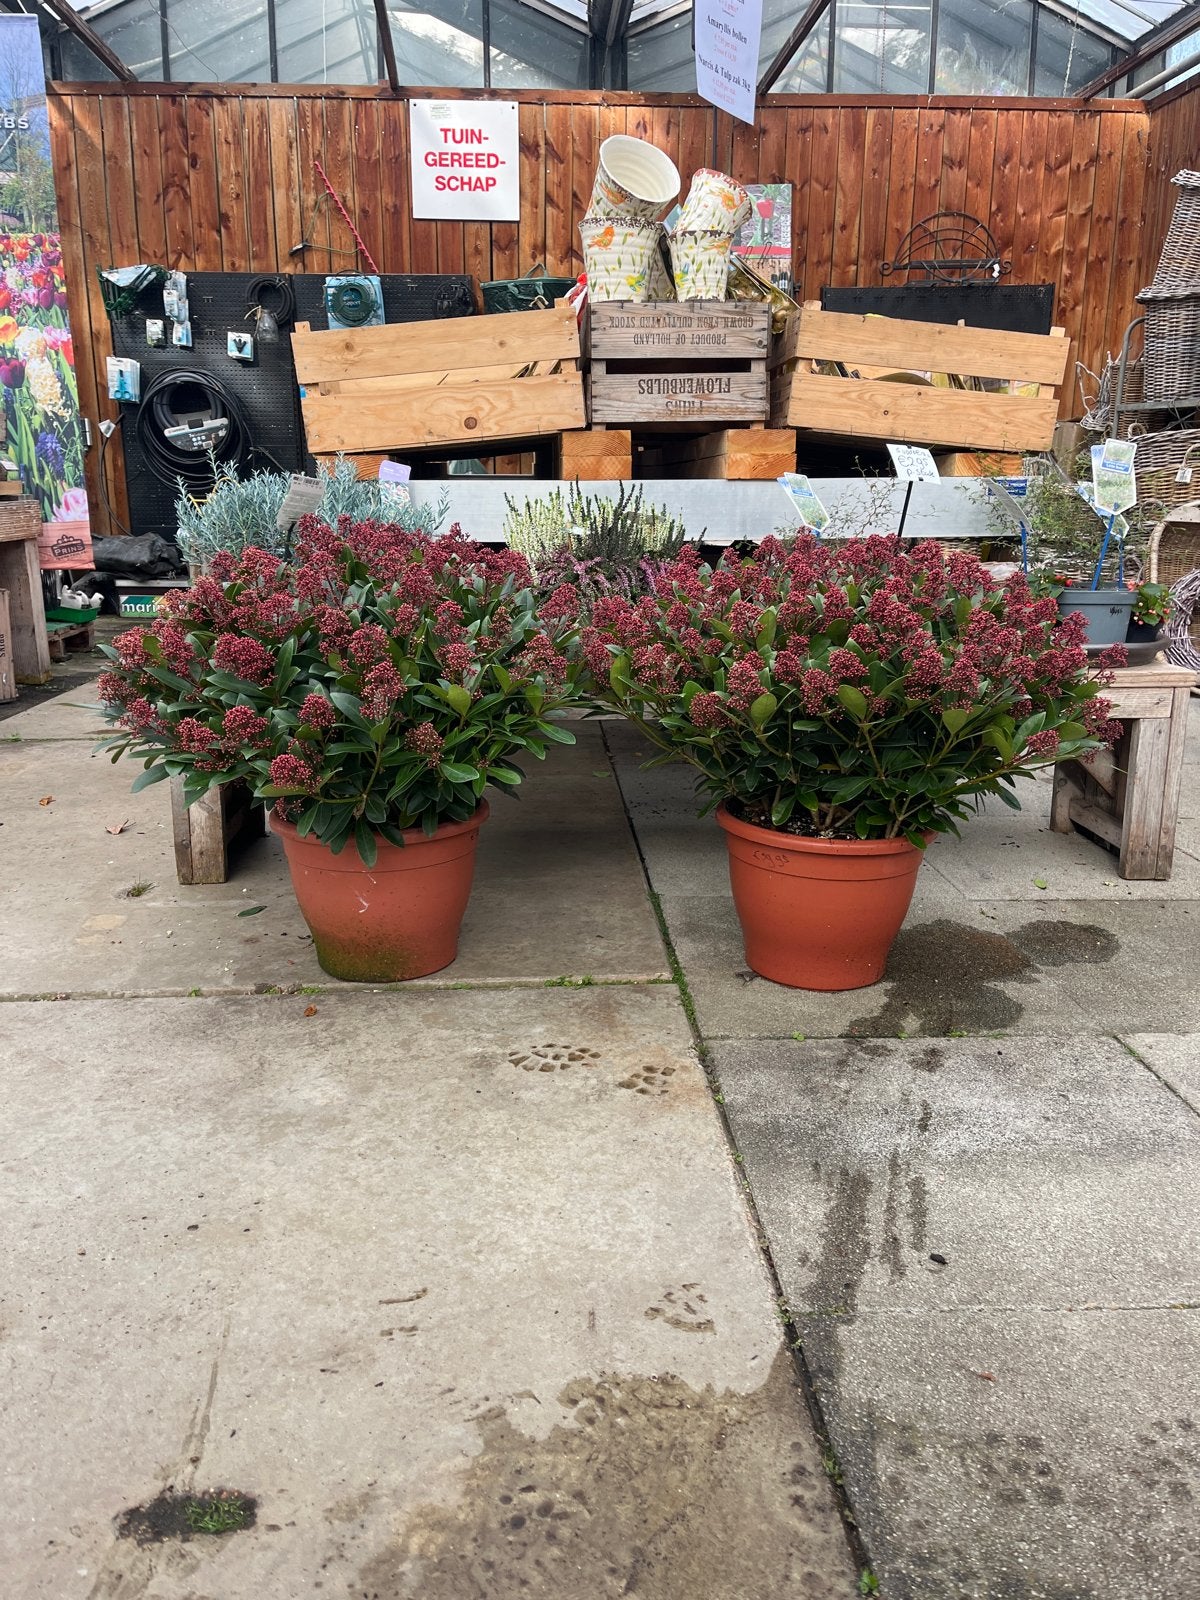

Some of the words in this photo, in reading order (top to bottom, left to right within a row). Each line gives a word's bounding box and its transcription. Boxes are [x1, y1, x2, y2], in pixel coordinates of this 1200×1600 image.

[706, 15, 732, 35] Amaryllis
[731, 28, 748, 44] bollen
[698, 54, 714, 71] Narcis
[714, 65, 720, 74] &
[720, 67, 732, 82] Tulp
[732, 75, 742, 87] zak
[0, 117, 29, 129] BS
[440, 128, 489, 144] TUIN-
[424, 151, 506, 169] GEREED-
[435, 175, 497, 192] SCHAP
[609, 316, 636, 328] STOCK
[641, 316, 693, 328] CULTIVATED
[697, 316, 719, 328] FROM
[722, 316, 754, 328] GROWN
[633, 333, 671, 345] HOLLAND
[675, 333, 686, 345] OF
[690, 333, 727, 345] PRODUCT
[637, 377, 731, 395] FLOWERBULBS
[54, 543, 84, 556] PRINS
